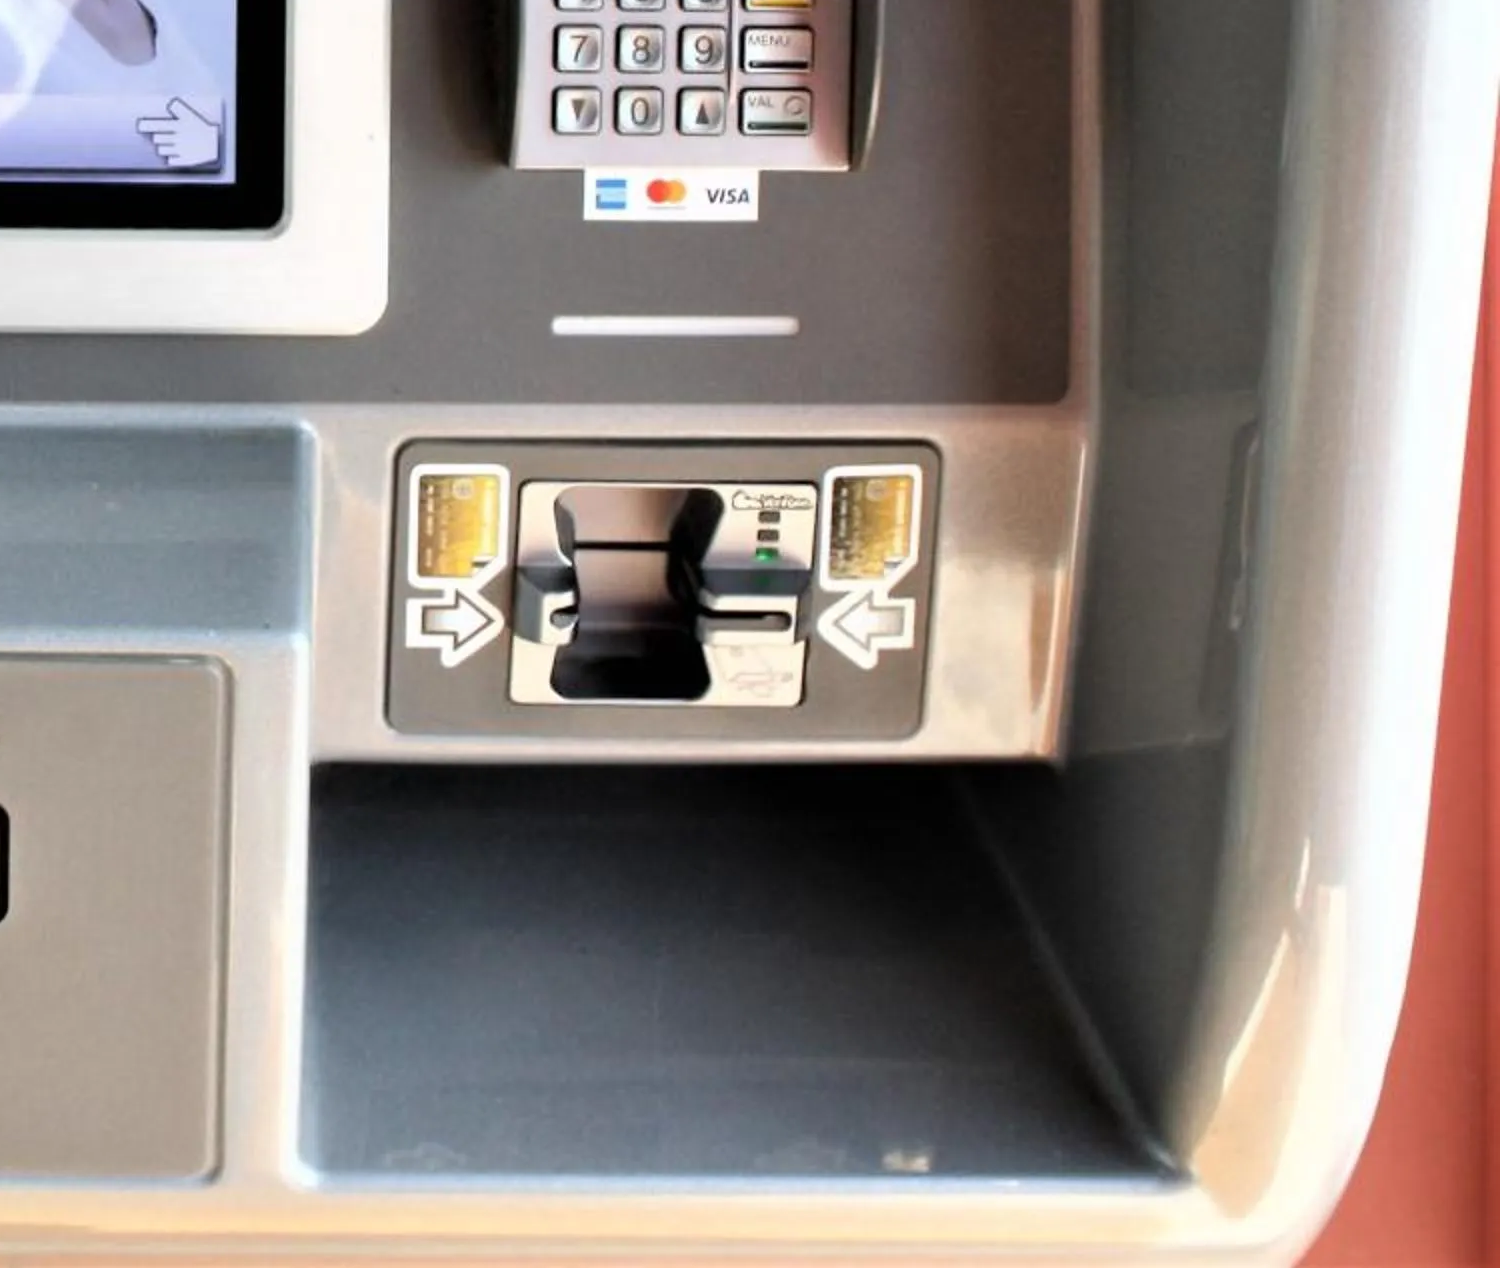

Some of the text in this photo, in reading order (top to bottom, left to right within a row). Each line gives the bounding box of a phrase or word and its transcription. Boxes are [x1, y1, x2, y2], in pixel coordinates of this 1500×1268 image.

[570, 35, 714, 64] 7 8 9
[631, 97, 649, 125] 0
[706, 188, 750, 205] VISA
